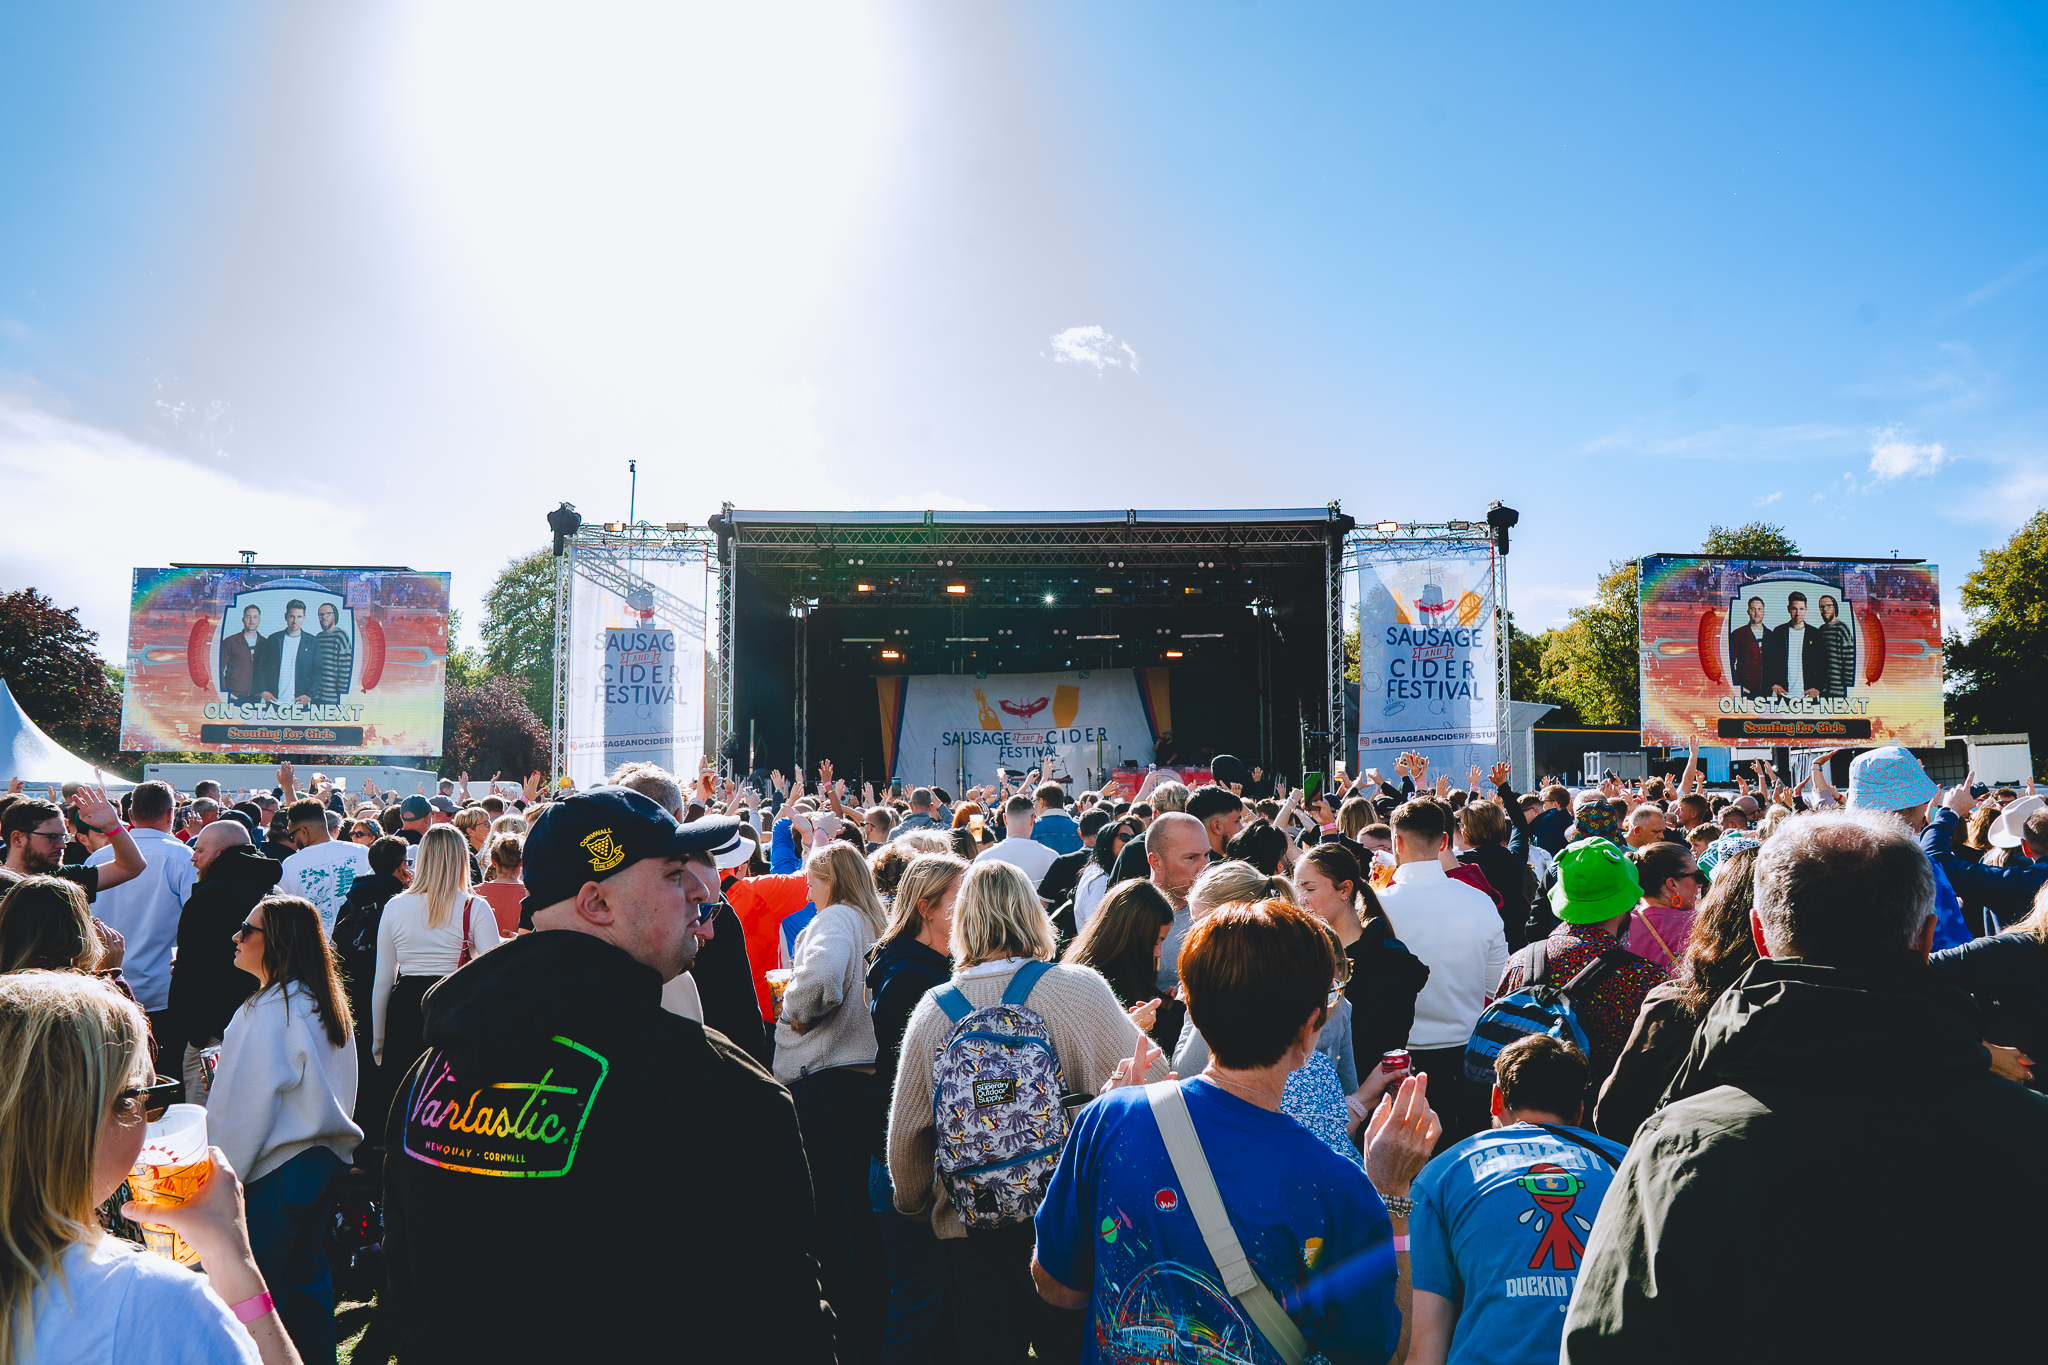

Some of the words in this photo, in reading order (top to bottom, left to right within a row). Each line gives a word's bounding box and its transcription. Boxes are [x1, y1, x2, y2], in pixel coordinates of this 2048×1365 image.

[594, 632, 689, 653] SAUSAGE
[1386, 626, 1483, 648] SAUSAGE
[632, 653, 650, 662] AND
[1424, 648, 1443, 658] AND
[598, 664, 680, 684] CIDER
[1390, 659, 1475, 680] CIDER
[594, 685, 688, 705] FESTIVAL
[1387, 679, 1483, 700] FESTIVAL
[203, 702, 234, 719] ON
[240, 702, 304, 720] STAGE
[310, 703, 364, 721] NEXT
[1719, 695, 1748, 713] ON
[1753, 696, 1814, 714] STAGE
[1819, 697, 1870, 714] NEXT
[228, 726, 282, 742] Scouting
[283, 727, 303, 740] for
[304, 728, 336, 741] Girls
[942, 731, 1013, 746] SAUSAGE
[1045, 727, 1108, 745] CIDER
[1371, 730, 1496, 745] @SAUSAGEANDCIDERFESTUK
[1743, 720, 1795, 736] Scouting
[1796, 721, 1815, 733] for
[1816, 721, 1846, 734] Girls
[578, 734, 703, 749] @SAUSAGEANDCIDERFESTUK
[1000, 746, 1060, 758] FESTIVAL
[580, 827, 613, 847] CORNWALL
[976, 1082, 1009, 1091] Superdry
[977, 1089, 1006, 1098] Outdoor
[425, 1140, 472, 1158] NEWQUAY
[483, 1151, 526, 1163] CORNWALL
[1505, 1275, 1568, 1298] DUCKIN
